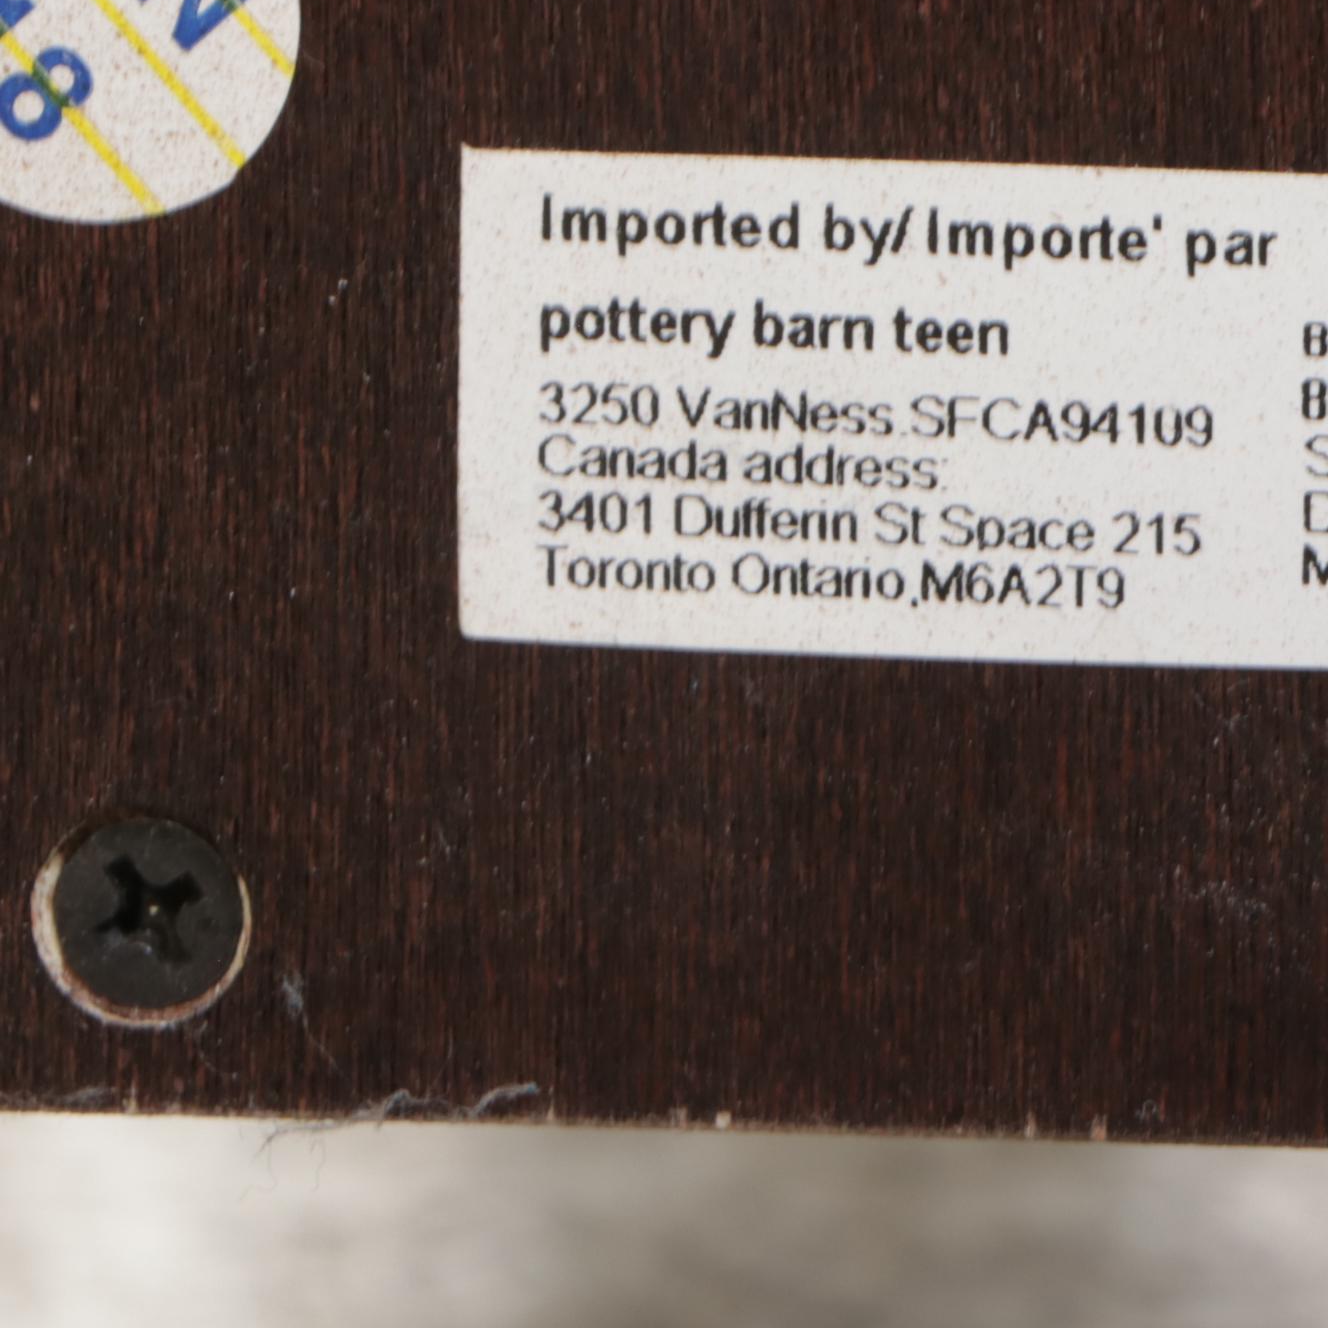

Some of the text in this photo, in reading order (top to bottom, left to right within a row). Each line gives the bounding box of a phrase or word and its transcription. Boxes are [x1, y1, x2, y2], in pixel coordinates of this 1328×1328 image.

[539, 193, 801, 259] Imported
[1184, 229, 1278, 279] par
[538, 297, 1010, 361] pottery barn teen
[538, 381, 661, 428] 3250
[537, 433, 949, 492] Canada address:
[538, 489, 1203, 557] 3401 Dufferin St Space 215
[537, 544, 717, 593] Toronto
